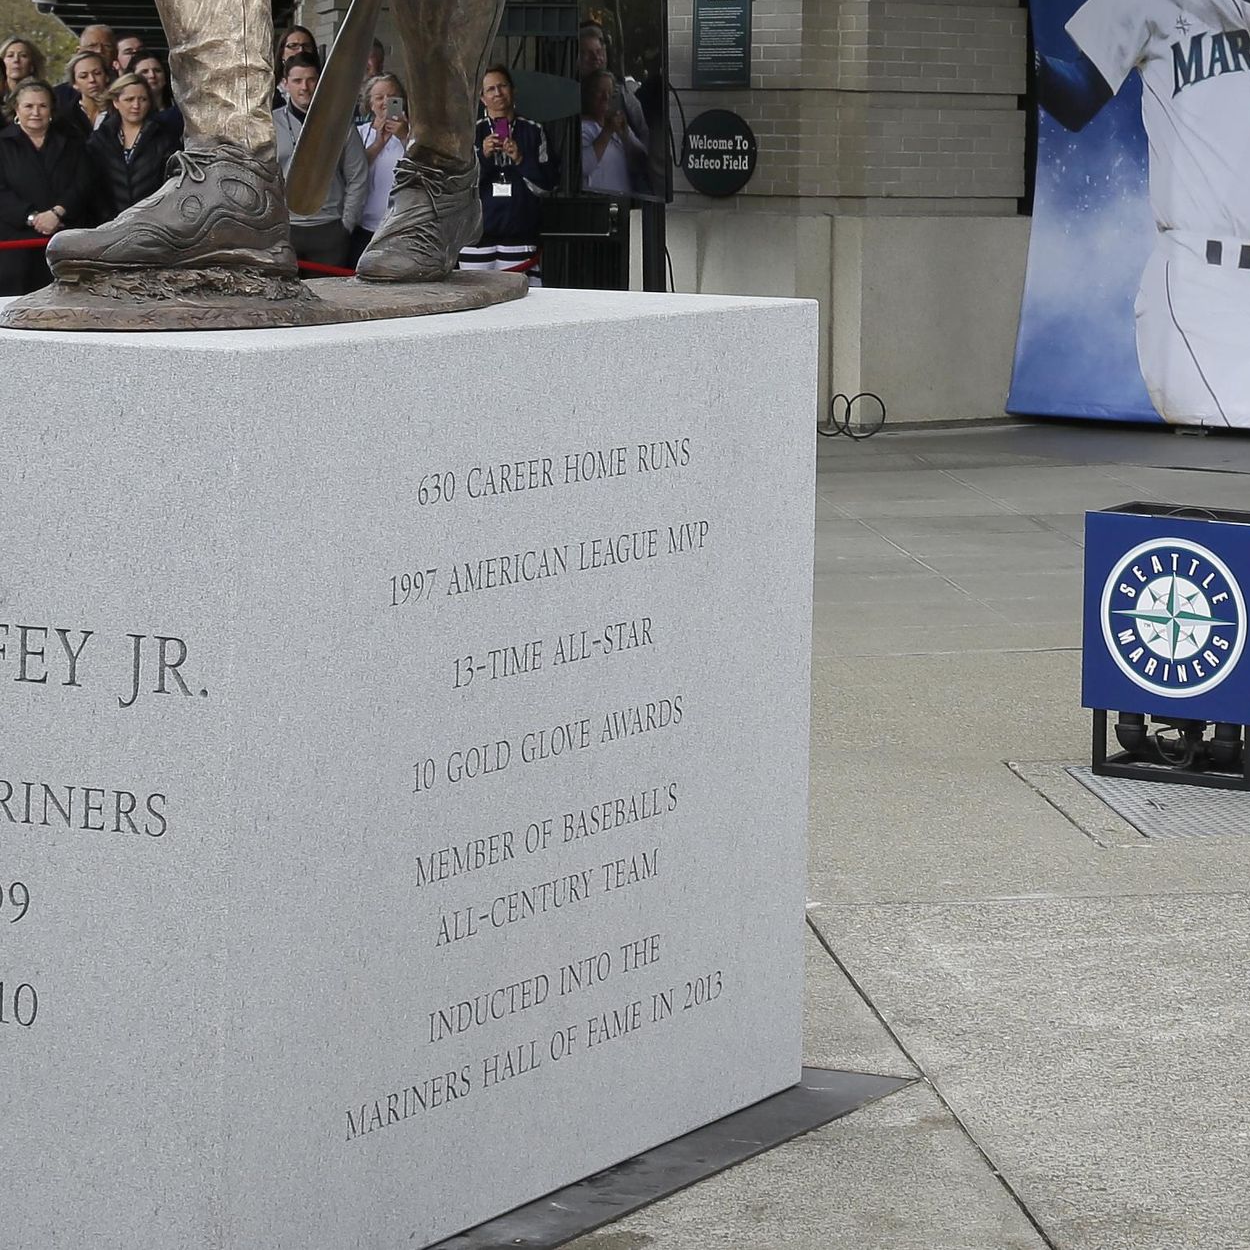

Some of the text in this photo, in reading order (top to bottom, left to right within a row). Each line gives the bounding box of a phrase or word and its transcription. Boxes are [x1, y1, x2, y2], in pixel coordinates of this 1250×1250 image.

[688, 134, 749, 150] Welcome To
[688, 154, 749, 170] Safeco Field
[416, 437, 691, 506] 630 CAREER HOME RUNS
[389, 520, 710, 607] 1997 AMERICAN LEAGUE MVP
[1119, 553, 1229, 605] SEATTLE
[117, 633, 209, 708] JR.
[452, 617, 653, 689] 13-TIME ALL-STAR
[1117, 629, 1230, 683] MARINERS
[412, 695, 684, 793] 10 GOLD GLOVE AWARDS
[415, 782, 678, 887] MEMBER OF BASEBALL'S
[0, 881, 31, 924] 9
[435, 848, 660, 947] ALL-CENTURY TEAM
[428, 934, 661, 1044] INDUCTED INTO THE
[344, 970, 724, 1142] MARINERS HALL OF FAME IN 2013
